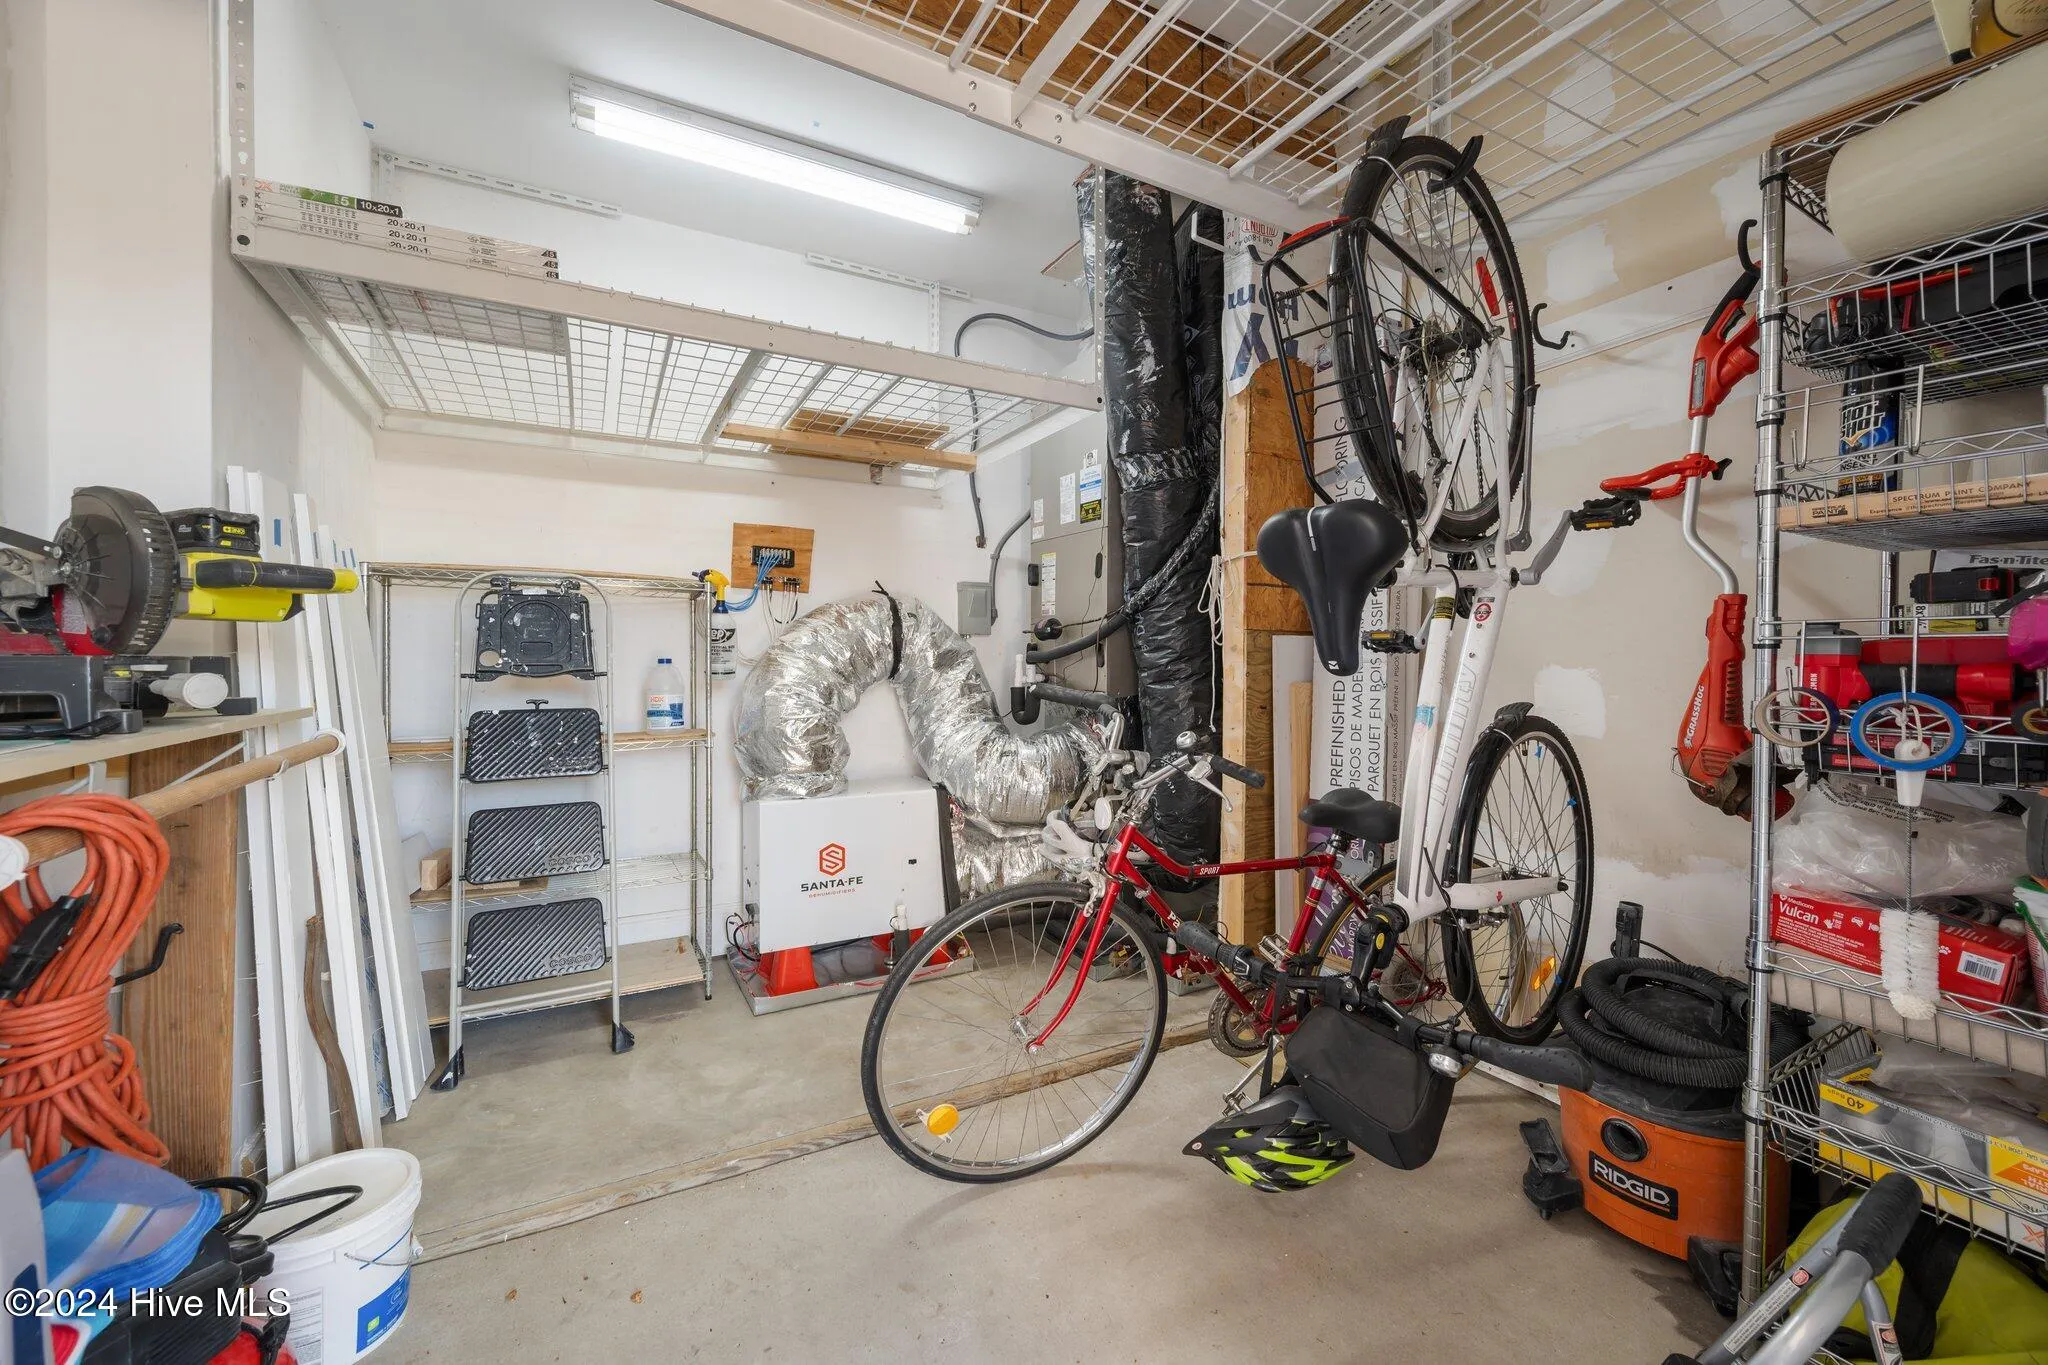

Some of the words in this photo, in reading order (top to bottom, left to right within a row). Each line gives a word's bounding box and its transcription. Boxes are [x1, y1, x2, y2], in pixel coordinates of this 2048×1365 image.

[1892, 492, 1941, 503] SPECTRUM
[1945, 488, 1974, 497] PAINT
[1978, 480, 2033, 493] COMPANY
[1370, 657, 1383, 692] BOIS
[1369, 700, 1381, 721] EN
[1686, 684, 1705, 738] GRASSHOG
[1330, 680, 1346, 788] PREFINISHED
[1351, 723, 1363, 743] DE
[1350, 747, 1362, 790] PISOS
[1367, 726, 1381, 793] PARQUET
[1199, 866, 1220, 875] SPORT
[1779, 901, 1819, 924] Vulcan
[1846, 1096, 1865, 1110] 40
[1594, 1158, 1670, 1205] RIDGID
